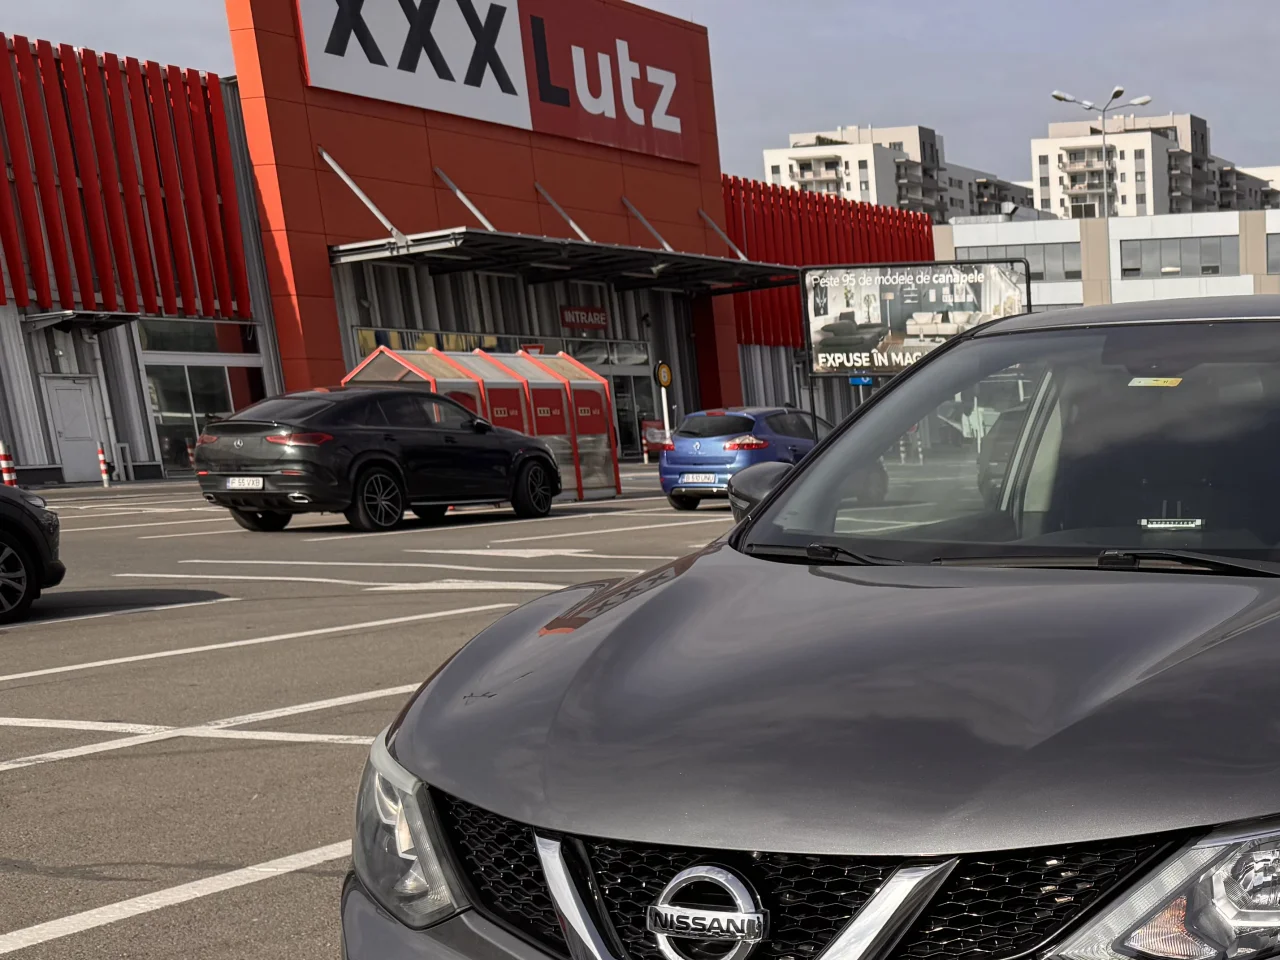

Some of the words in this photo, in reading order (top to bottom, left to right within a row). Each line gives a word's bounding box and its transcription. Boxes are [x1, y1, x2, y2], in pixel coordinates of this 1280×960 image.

[812, 275, 839, 287] Peste
[841, 273, 856, 286] 95
[859, 273, 872, 286] de
[875, 271, 914, 285] modele
[915, 270, 931, 284] de
[932, 269, 985, 286] canapele
[563, 310, 606, 325] INTRARE
[818, 352, 870, 367] EXPUSE
[872, 348, 889, 366] ÎN
[890, 351, 930, 366] MAG
[652, 912, 746, 933] NISSAN
